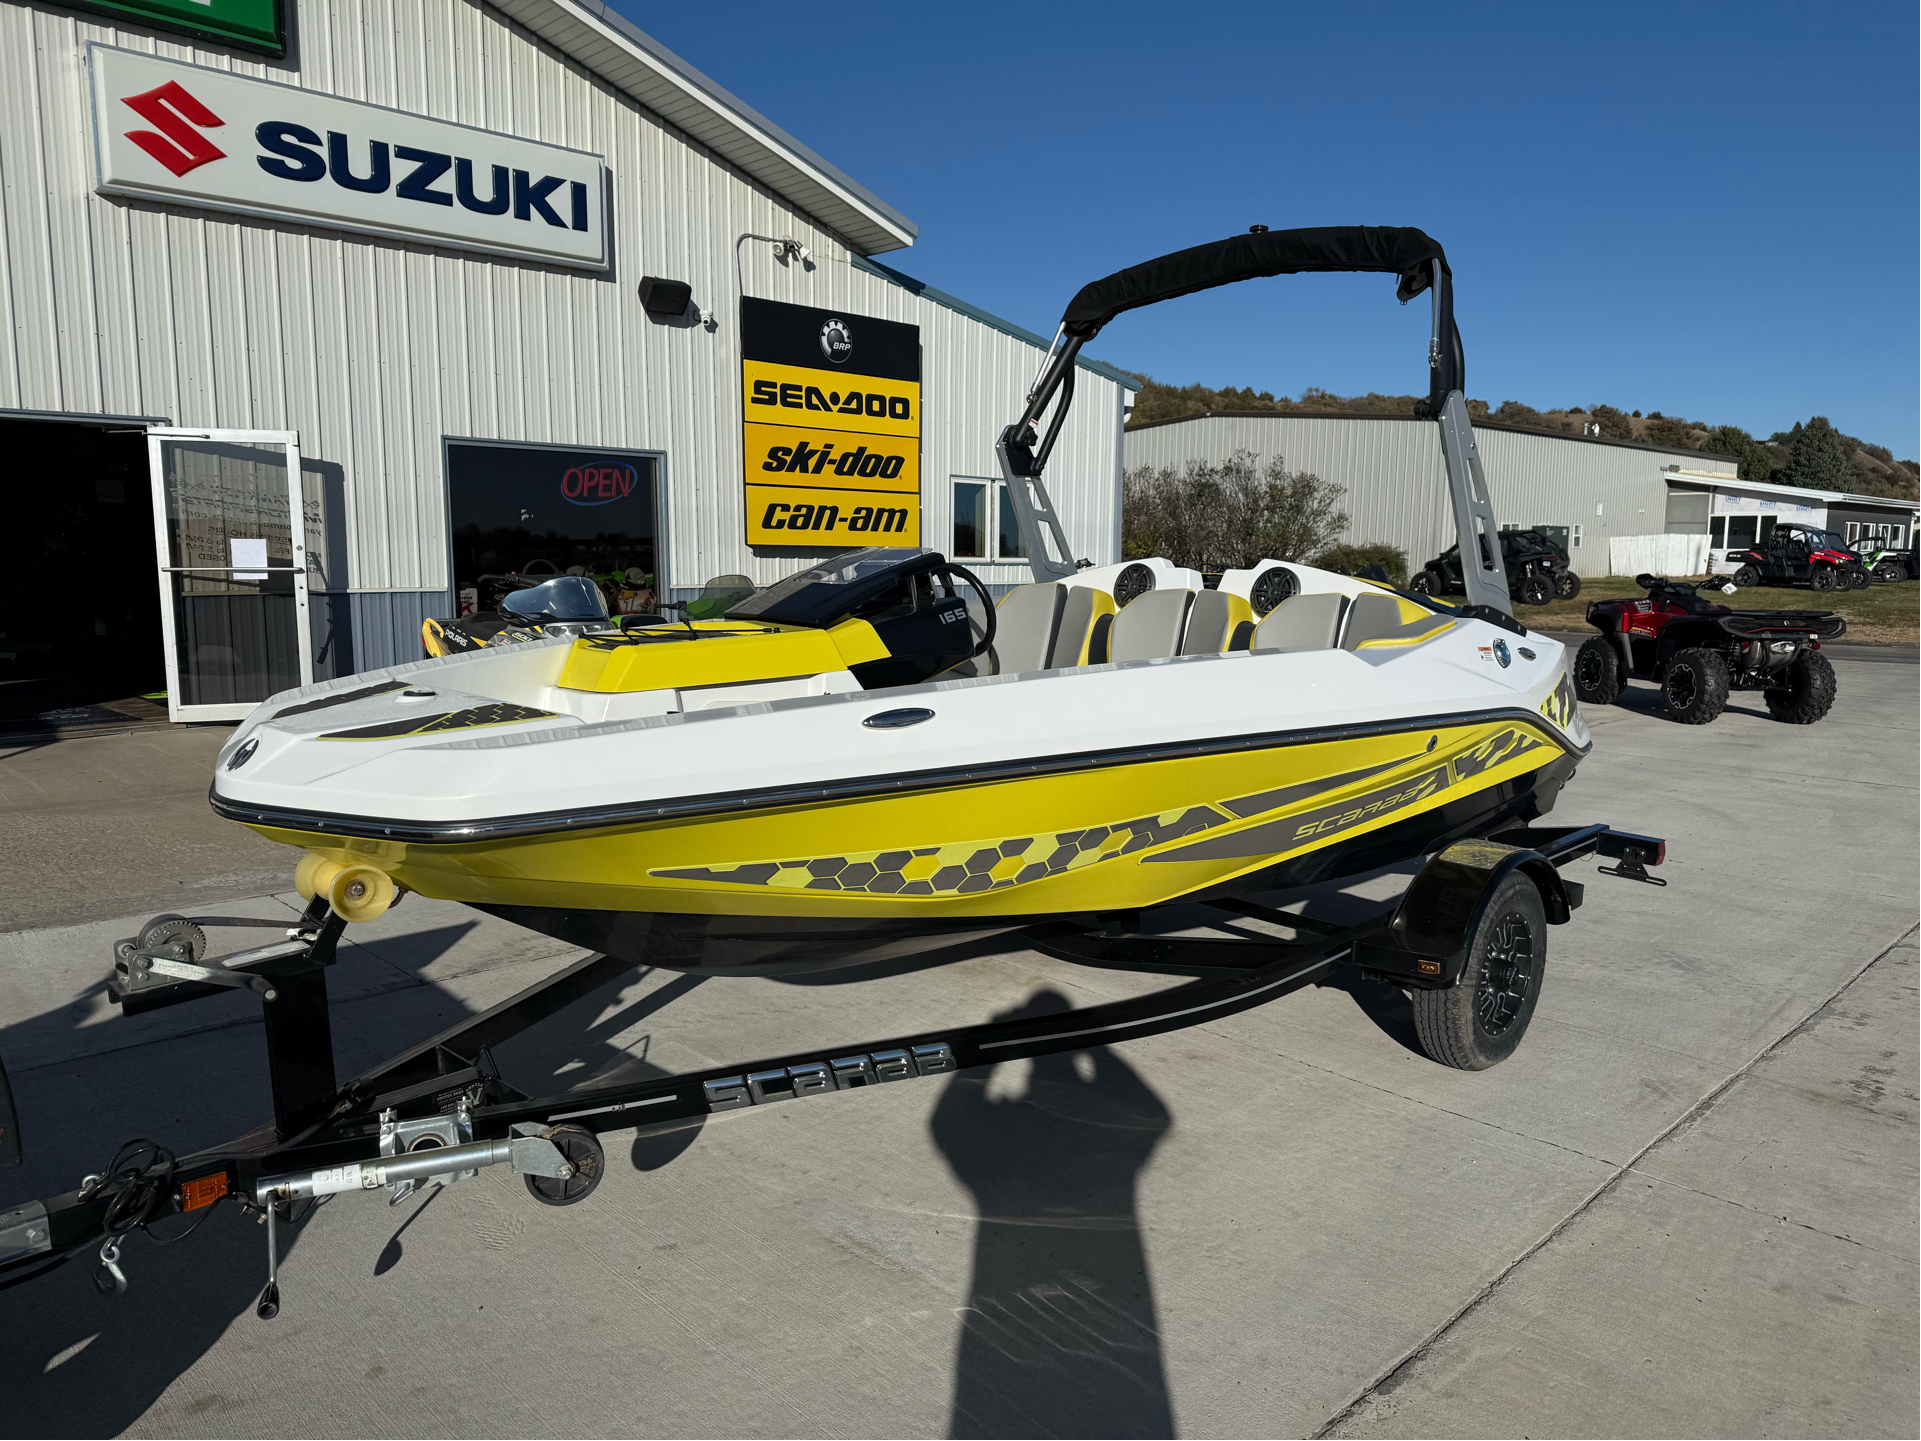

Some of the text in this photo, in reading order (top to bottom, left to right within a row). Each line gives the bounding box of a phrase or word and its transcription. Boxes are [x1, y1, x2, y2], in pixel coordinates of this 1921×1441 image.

[255, 121, 589, 232] SUZUKI
[833, 342, 851, 351] BRP
[762, 441, 905, 480] ski-doo
[563, 468, 631, 498] OPEN
[761, 503, 909, 533] can-am
[938, 607, 967, 625] 165
[445, 629, 468, 647] POLARIS
